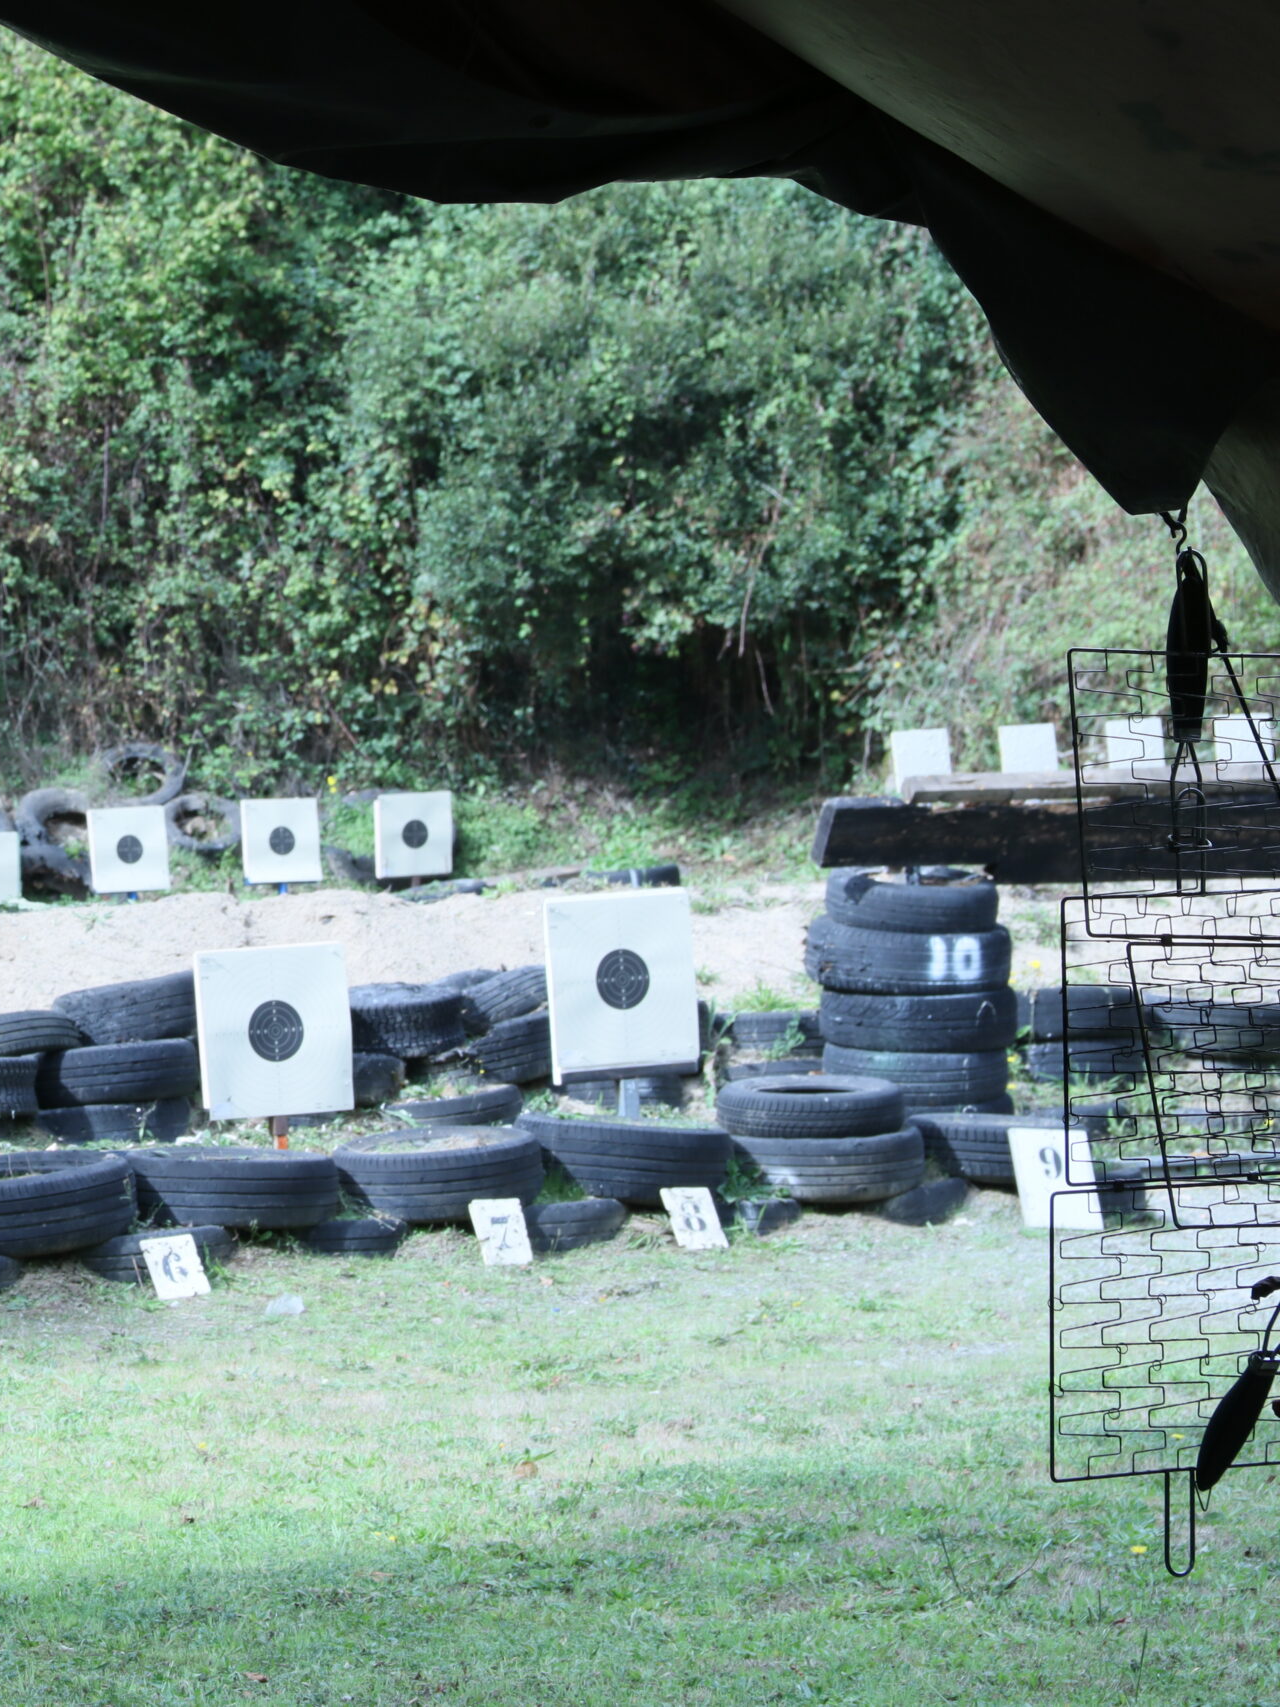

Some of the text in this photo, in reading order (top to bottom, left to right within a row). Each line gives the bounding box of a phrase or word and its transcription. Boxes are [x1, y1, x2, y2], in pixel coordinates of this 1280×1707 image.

[927, 936, 983, 980] 10
[1039, 1146, 1062, 1180] 9
[490, 1215, 512, 1249] 7
[680, 1203, 706, 1232] 8
[161, 1251, 189, 1284] 6
